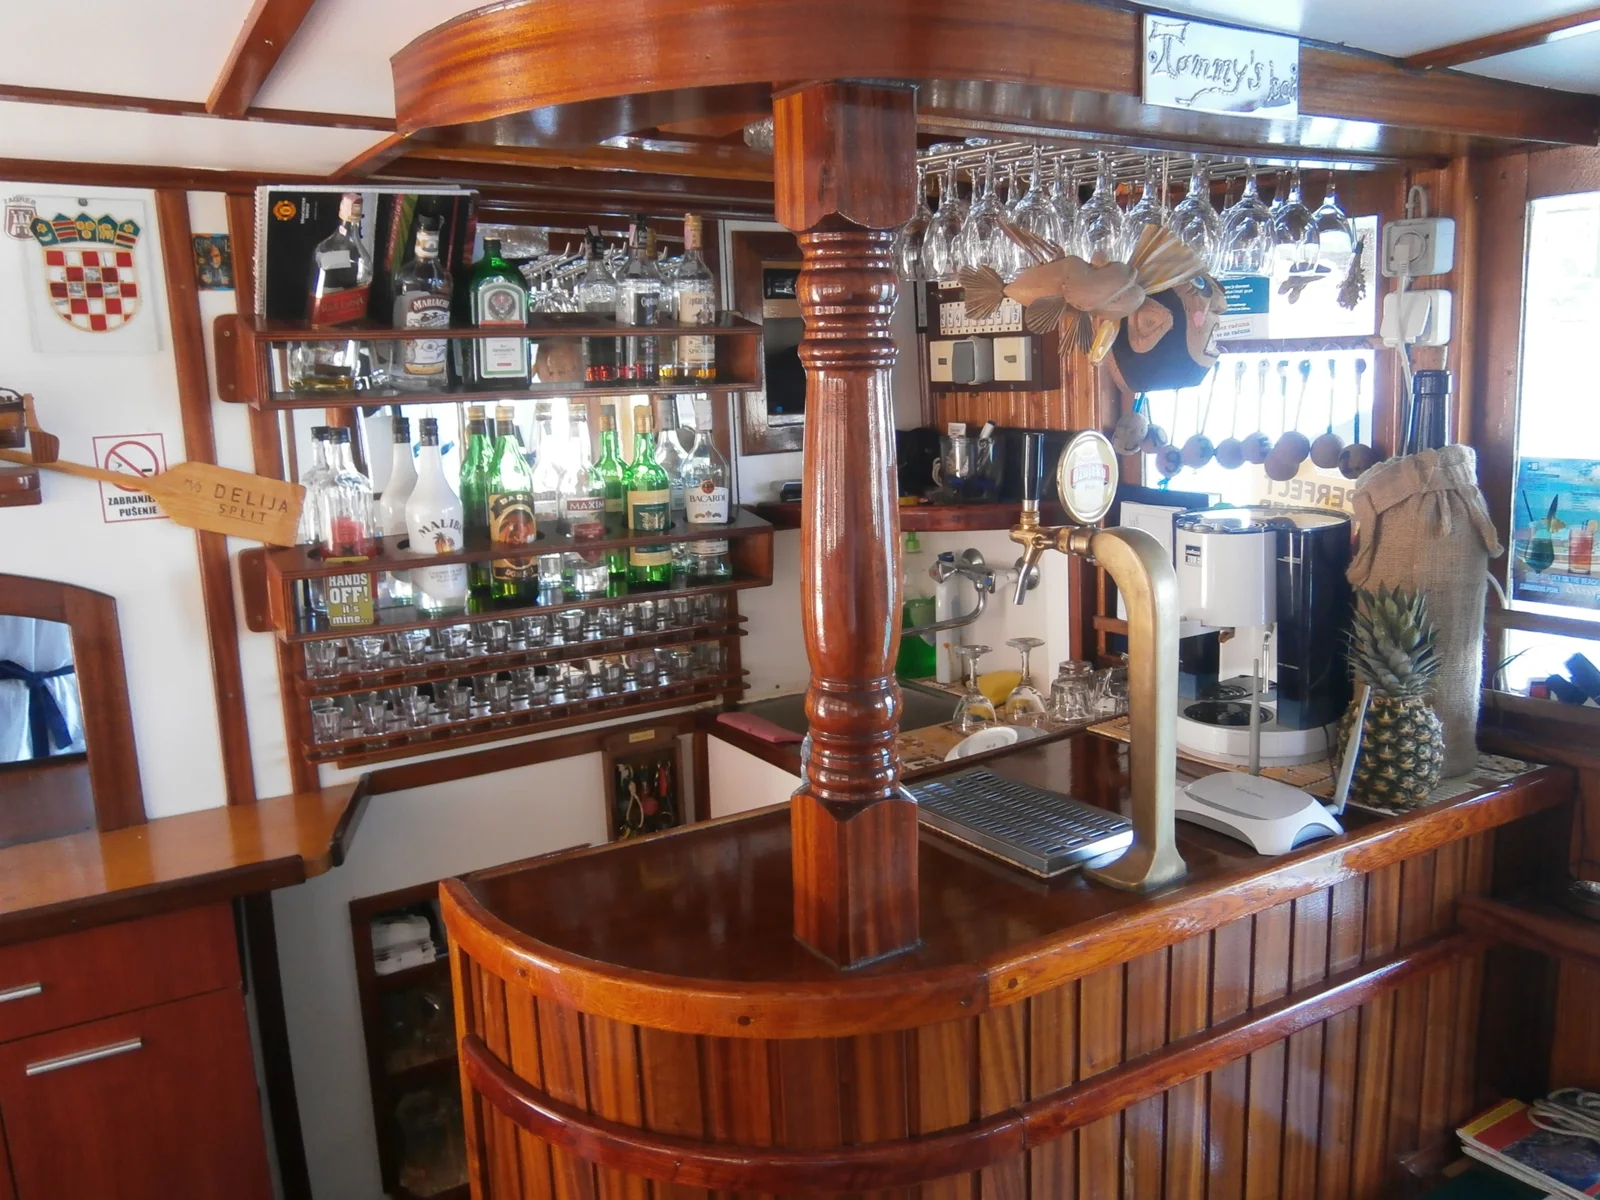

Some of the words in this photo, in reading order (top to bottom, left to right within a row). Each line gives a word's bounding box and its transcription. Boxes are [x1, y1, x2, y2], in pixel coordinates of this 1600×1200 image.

[1149, 20, 1264, 107] Tommy's
[412, 298, 449, 312] MARIACHI
[107, 494, 156, 506] ZABRANJE
[214, 483, 288, 513] DELIJA
[689, 494, 726, 503] BACARDI
[119, 506, 158, 517] PUŠENJE
[219, 503, 268, 522] SPLIT
[328, 573, 368, 587] HANDS
[329, 586, 369, 604] OFF!
[342, 603, 360, 614] it's
